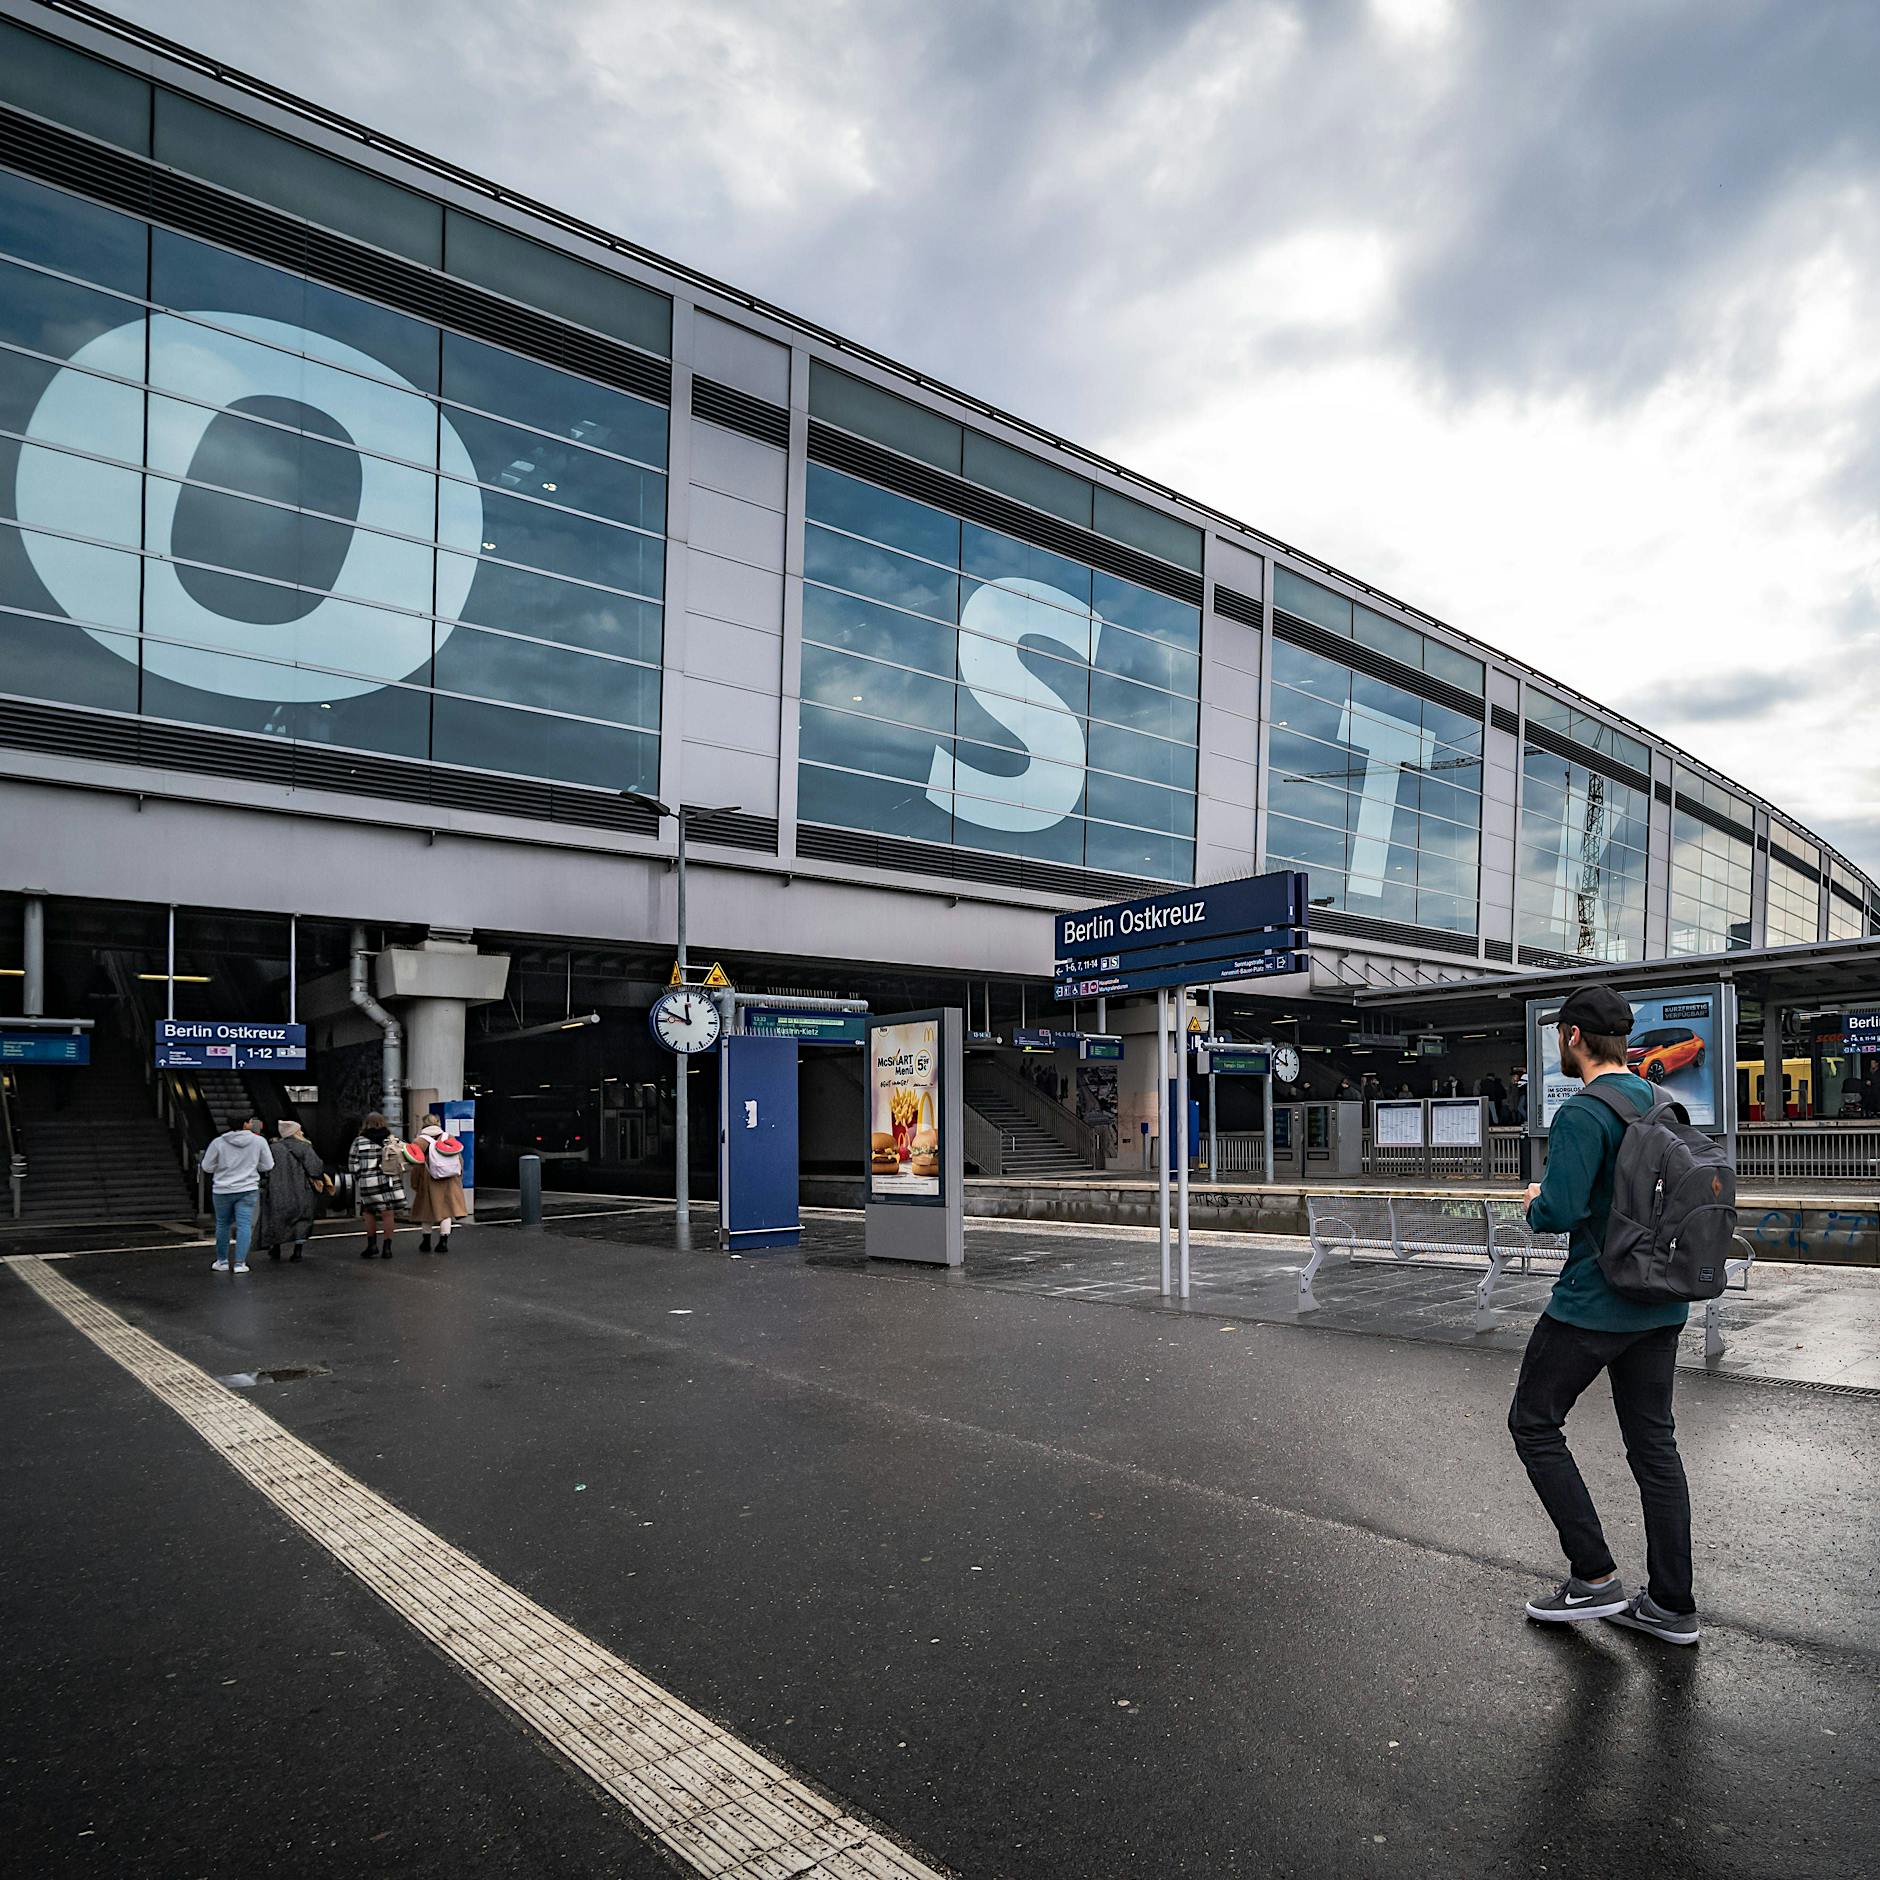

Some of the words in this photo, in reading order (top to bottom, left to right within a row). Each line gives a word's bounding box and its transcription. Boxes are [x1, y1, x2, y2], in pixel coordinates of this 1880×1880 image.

[1064, 915, 1114, 945] Berlin
[1120, 901, 1206, 934] Ostkreuz
[1664, 1003, 1708, 1013] KURZFRISTIG
[1849, 1015, 1880, 1029] Berli
[164, 1024, 213, 1038] Berlin
[217, 1025, 286, 1040] Ostkreuz
[247, 1048, 272, 1059] 1-12
